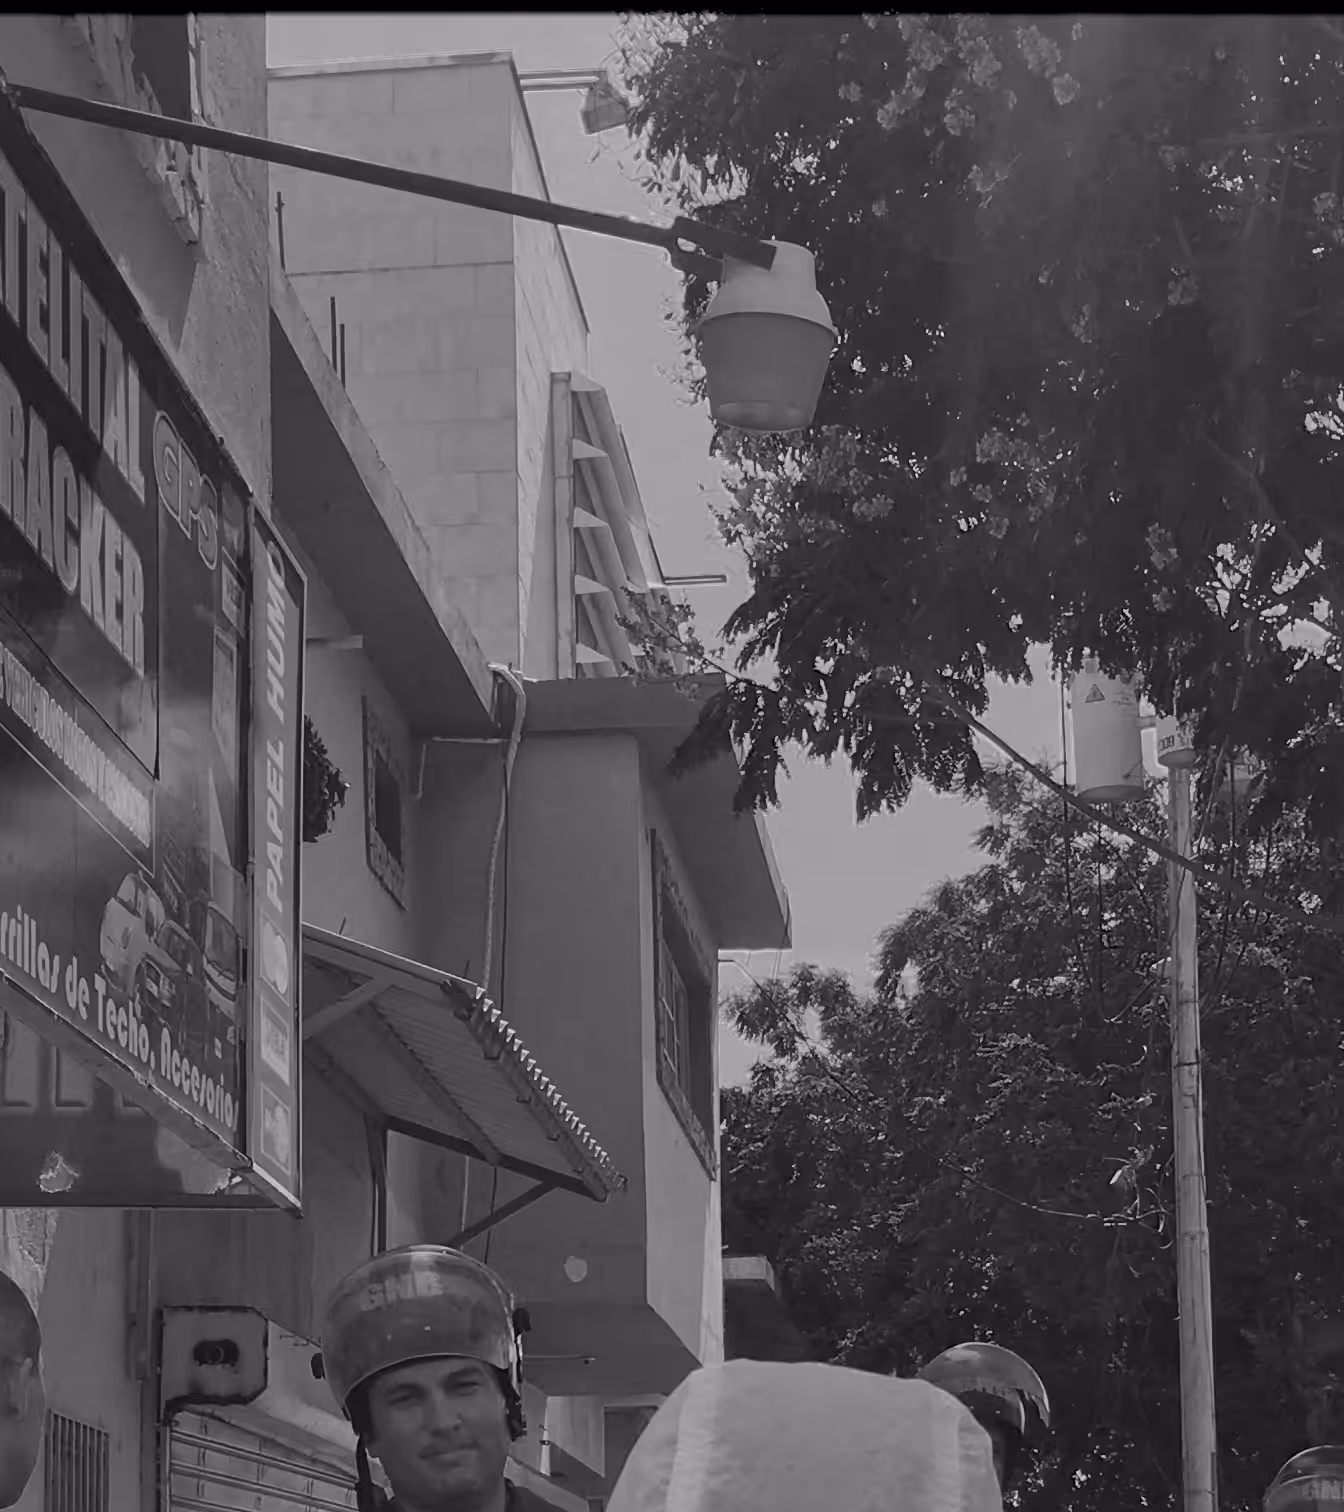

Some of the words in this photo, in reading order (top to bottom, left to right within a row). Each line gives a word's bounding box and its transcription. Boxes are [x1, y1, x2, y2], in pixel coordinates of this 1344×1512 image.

[153, 411, 218, 571] GPS
[265, 737, 285, 914] PAPEL
[65, 955, 91, 1021] de
[160, 1025, 240, 1132] Accesorios
